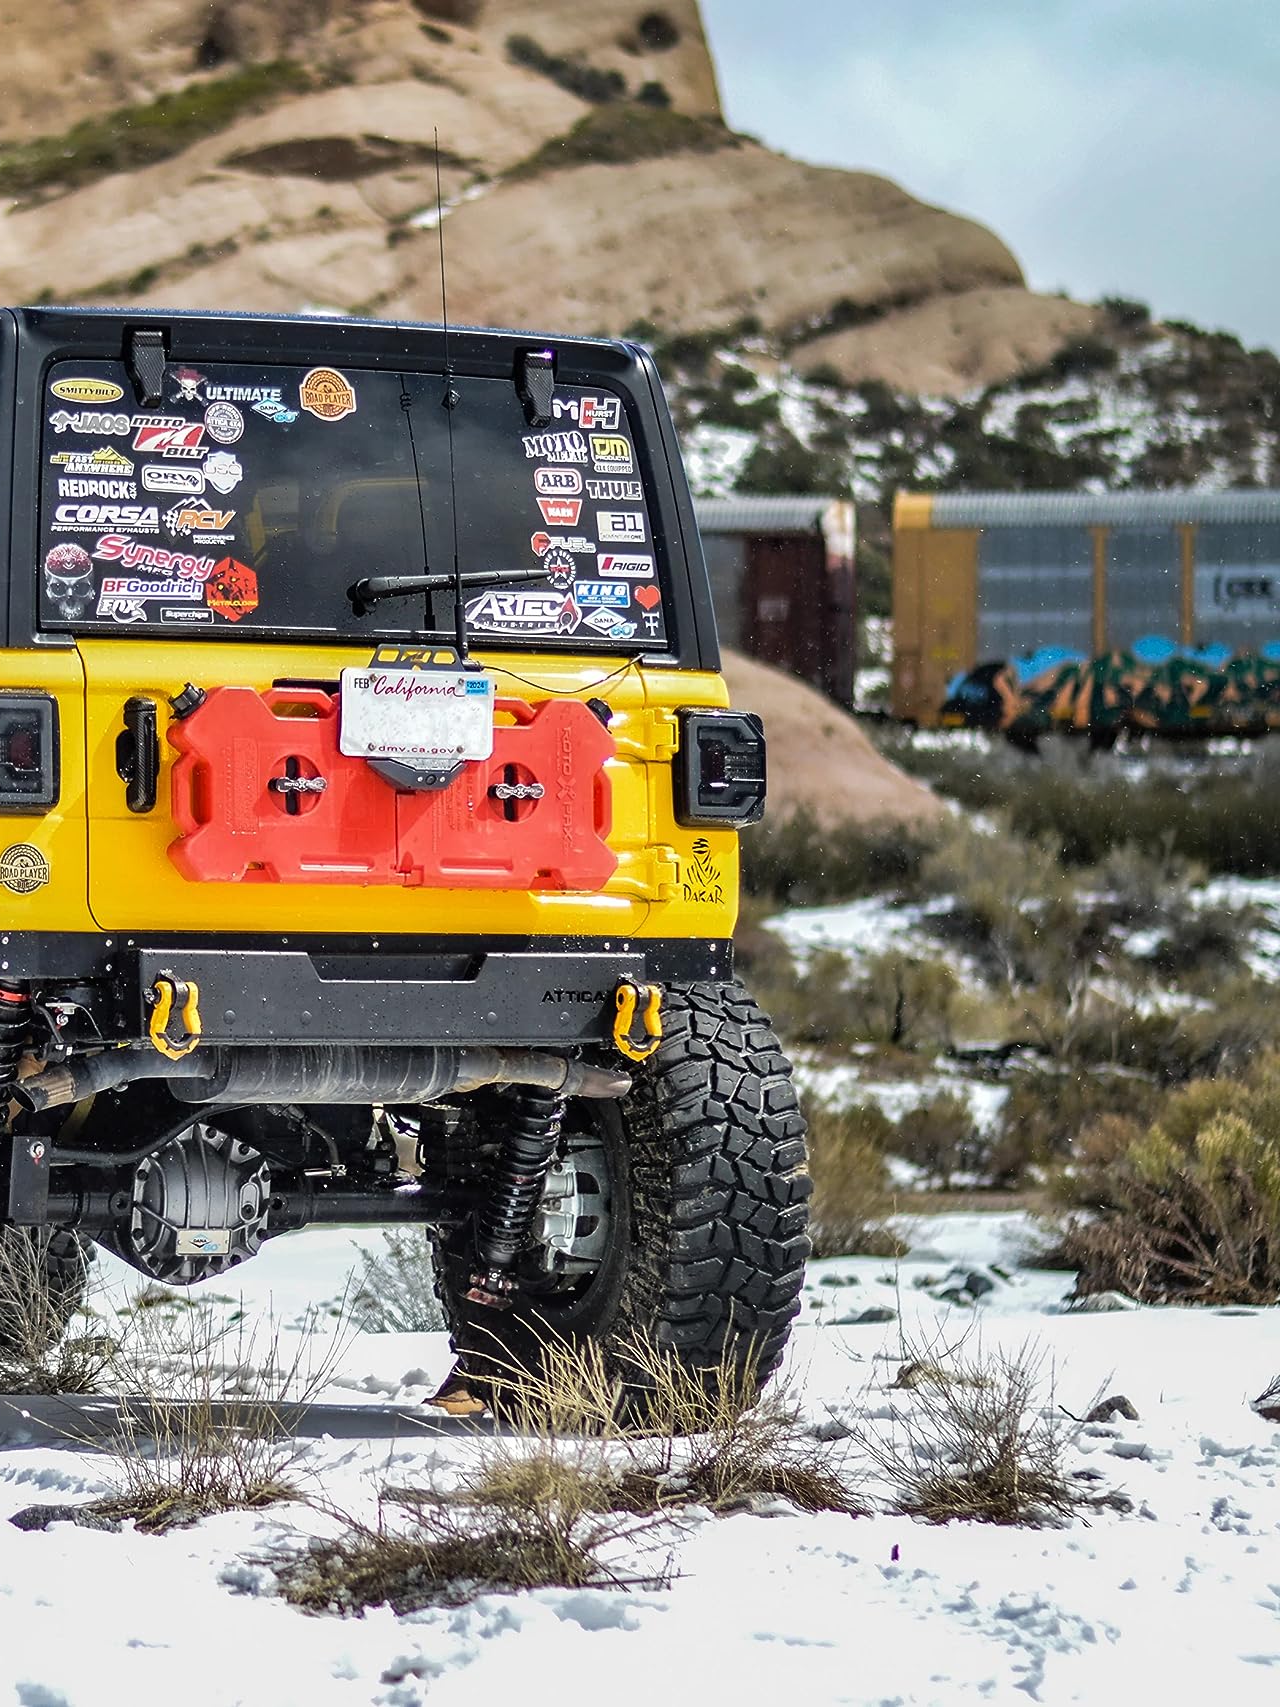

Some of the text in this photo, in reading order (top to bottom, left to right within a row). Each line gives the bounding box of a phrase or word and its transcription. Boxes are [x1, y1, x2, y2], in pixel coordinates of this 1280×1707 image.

[59, 386, 116, 397] SMITTYBILT
[206, 387, 282, 402] ULTIMATE
[305, 391, 351, 405] ROAD PLAYER
[585, 410, 615, 418] HURST
[73, 413, 129, 434] JAOS
[132, 418, 183, 427] MOTO
[165, 447, 207, 457] BILT
[523, 432, 584, 458] MOTO
[70, 455, 94, 464] FAST
[66, 463, 132, 474] ANYWHERE
[541, 474, 576, 488] ARB
[58, 479, 130, 499] REDROCK
[587, 481, 641, 499] THULE
[55, 505, 159, 525] CORSA
[176, 509, 236, 530] RCV
[51, 525, 114, 533] PERFORMANCE
[92, 533, 215, 582] Synergy
[611, 562, 650, 573] RIGID
[103, 578, 202, 593] BFGoodrich
[577, 584, 627, 596] KING
[470, 592, 563, 620] ARTEC
[165, 610, 209, 619] Superchips
[354, 677, 370, 689] FEB
[373, 674, 466, 701] California
[469, 681, 485, 689] 2024
[378, 744, 455, 754] dmv.ca.gov
[0, 866, 48, 881] ROAD PLAYER
[683, 883, 725, 905] DAKAR
[542, 990, 604, 1003] ATTICA
